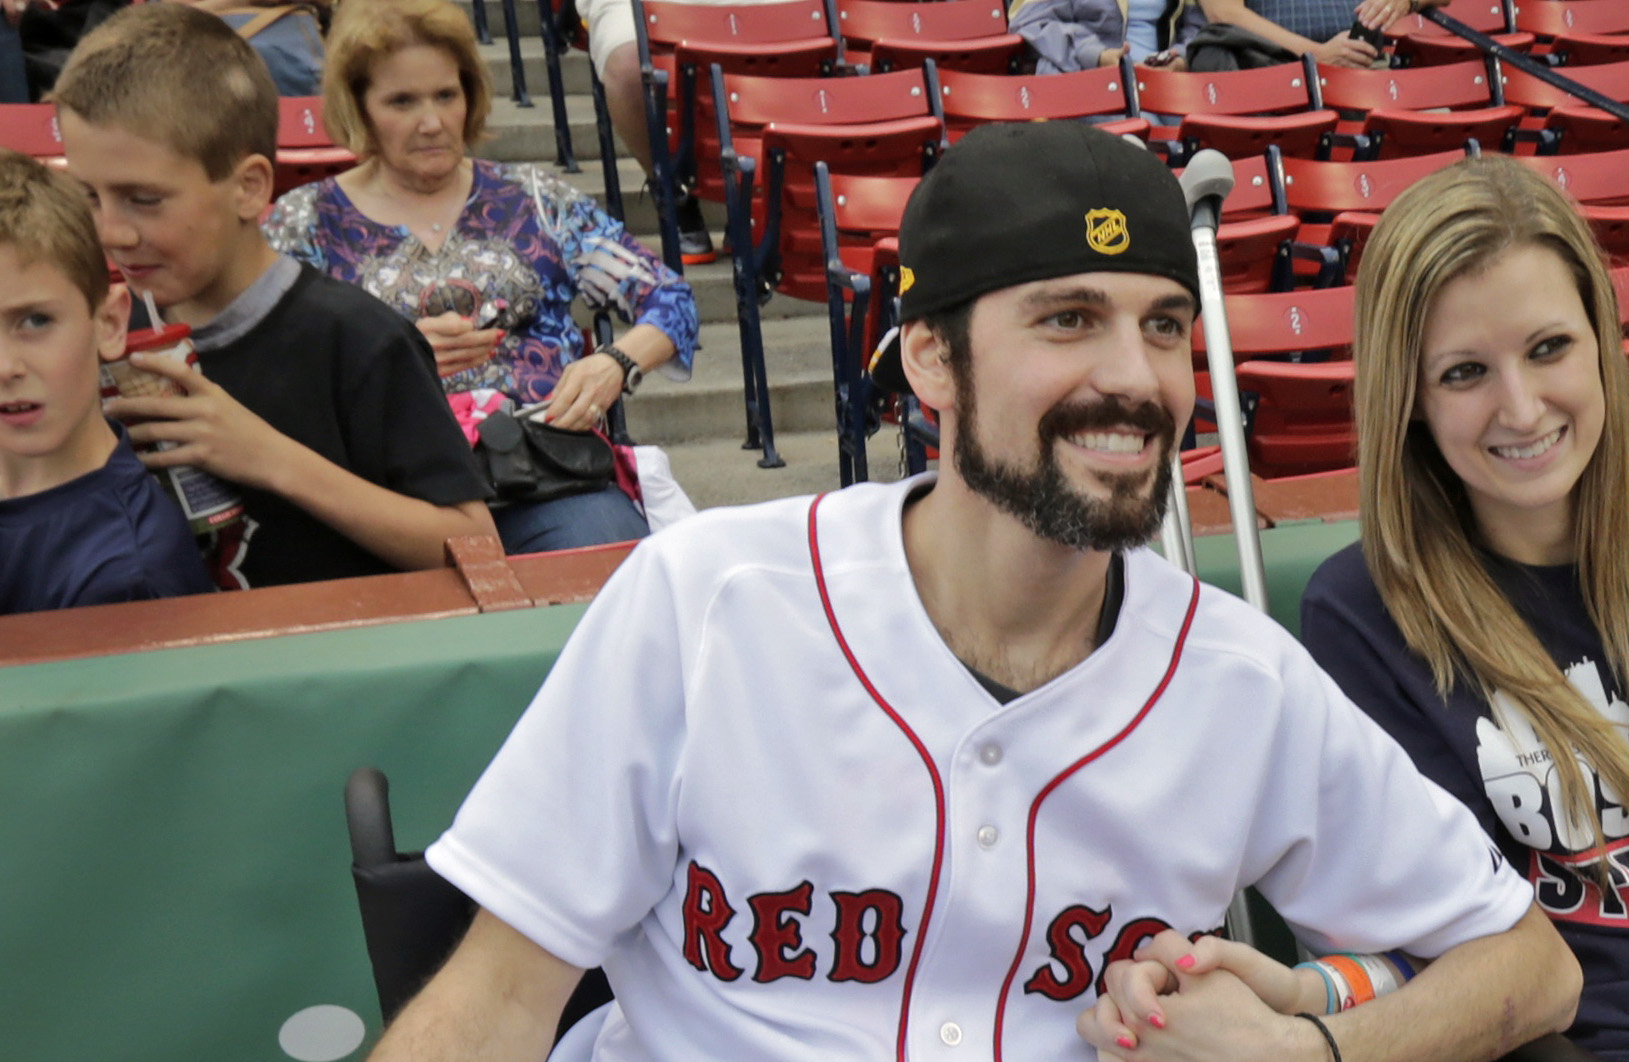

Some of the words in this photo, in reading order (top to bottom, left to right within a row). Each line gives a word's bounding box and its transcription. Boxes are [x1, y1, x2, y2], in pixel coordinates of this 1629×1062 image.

[1097, 219, 1122, 245] NHL
[682, 860, 907, 983] RED
[1025, 904, 1225, 1001] SO
